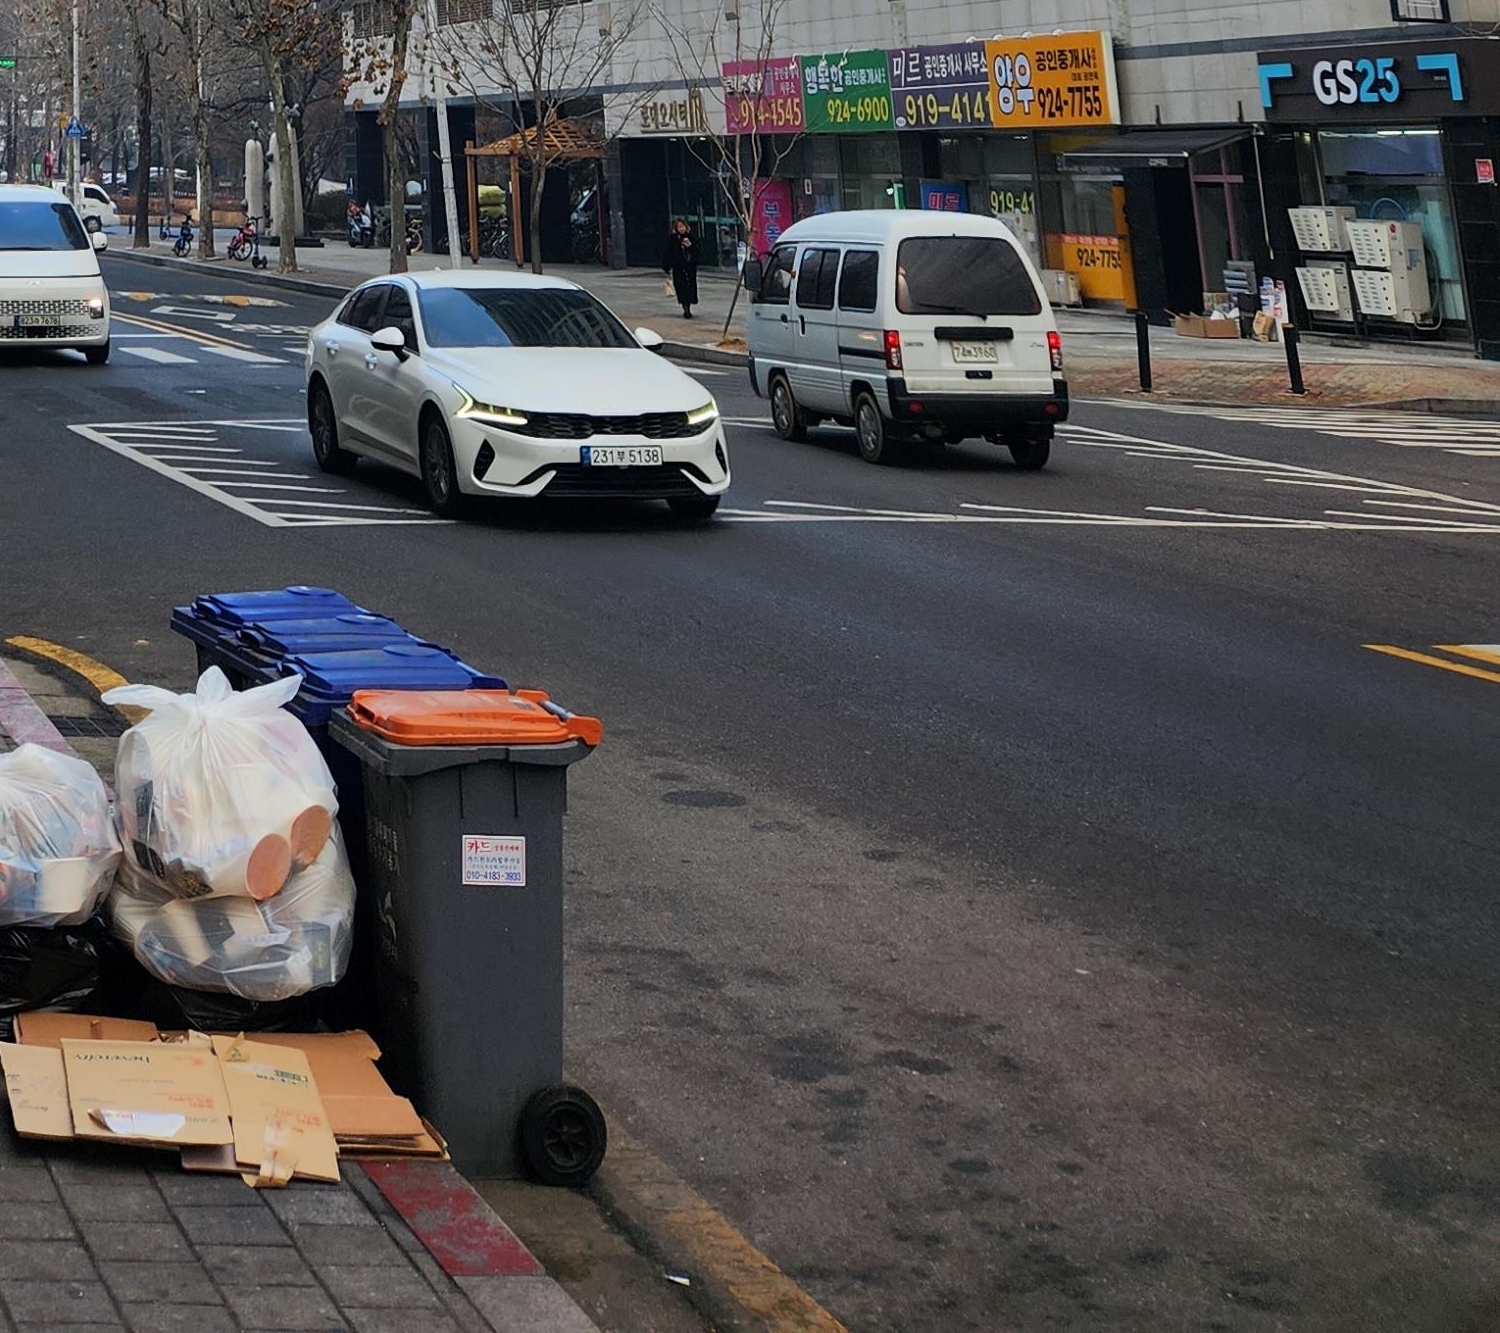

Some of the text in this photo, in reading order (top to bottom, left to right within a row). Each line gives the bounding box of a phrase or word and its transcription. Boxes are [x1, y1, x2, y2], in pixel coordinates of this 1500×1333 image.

[844, 68, 883, 86] 공인중개사
[893, 50, 922, 87] 미르
[924, 54, 963, 79] 공인중개사
[994, 52, 1035, 115] 양우
[1035, 48, 1092, 72] 공인중개사
[1312, 58, 1400, 106] GS25
[828, 97, 889, 122] 924-6900
[1038, 85, 1102, 119] 924-7755
